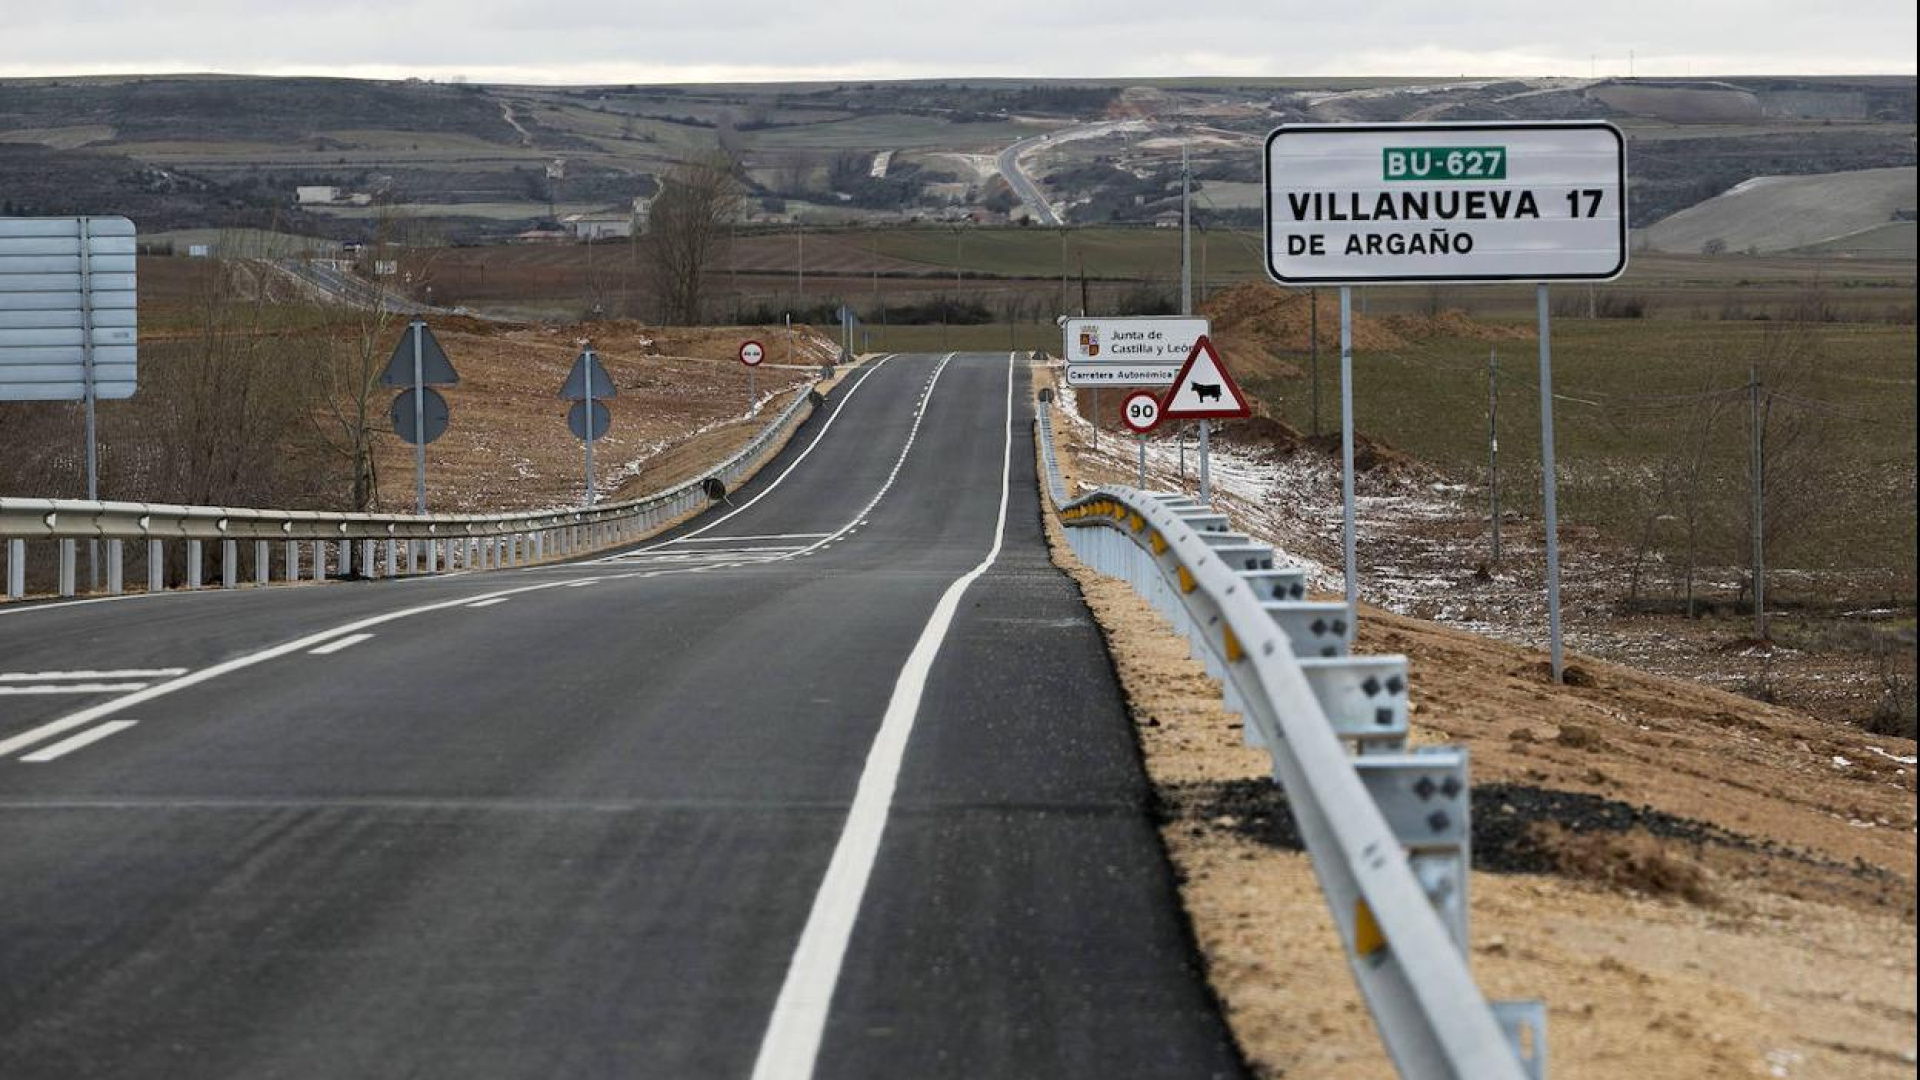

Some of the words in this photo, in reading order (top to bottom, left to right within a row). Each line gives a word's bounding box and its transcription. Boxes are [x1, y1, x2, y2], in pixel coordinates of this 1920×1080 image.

[1387, 151, 1501, 176] BU-627
[1288, 190, 1539, 221] VILLANUEVA
[1566, 189, 1604, 218] 17
[1287, 234, 1325, 255] DE
[1345, 228, 1473, 255] ARGAÑO
[1111, 330, 1144, 340] Junta
[1147, 330, 1162, 340] de
[1111, 343, 1153, 353] Castilla
[1157, 346, 1163, 355] y
[1070, 371, 1113, 379] Carretera
[1117, 370, 1172, 379] Autonómica
[1131, 405, 1153, 417] 90
